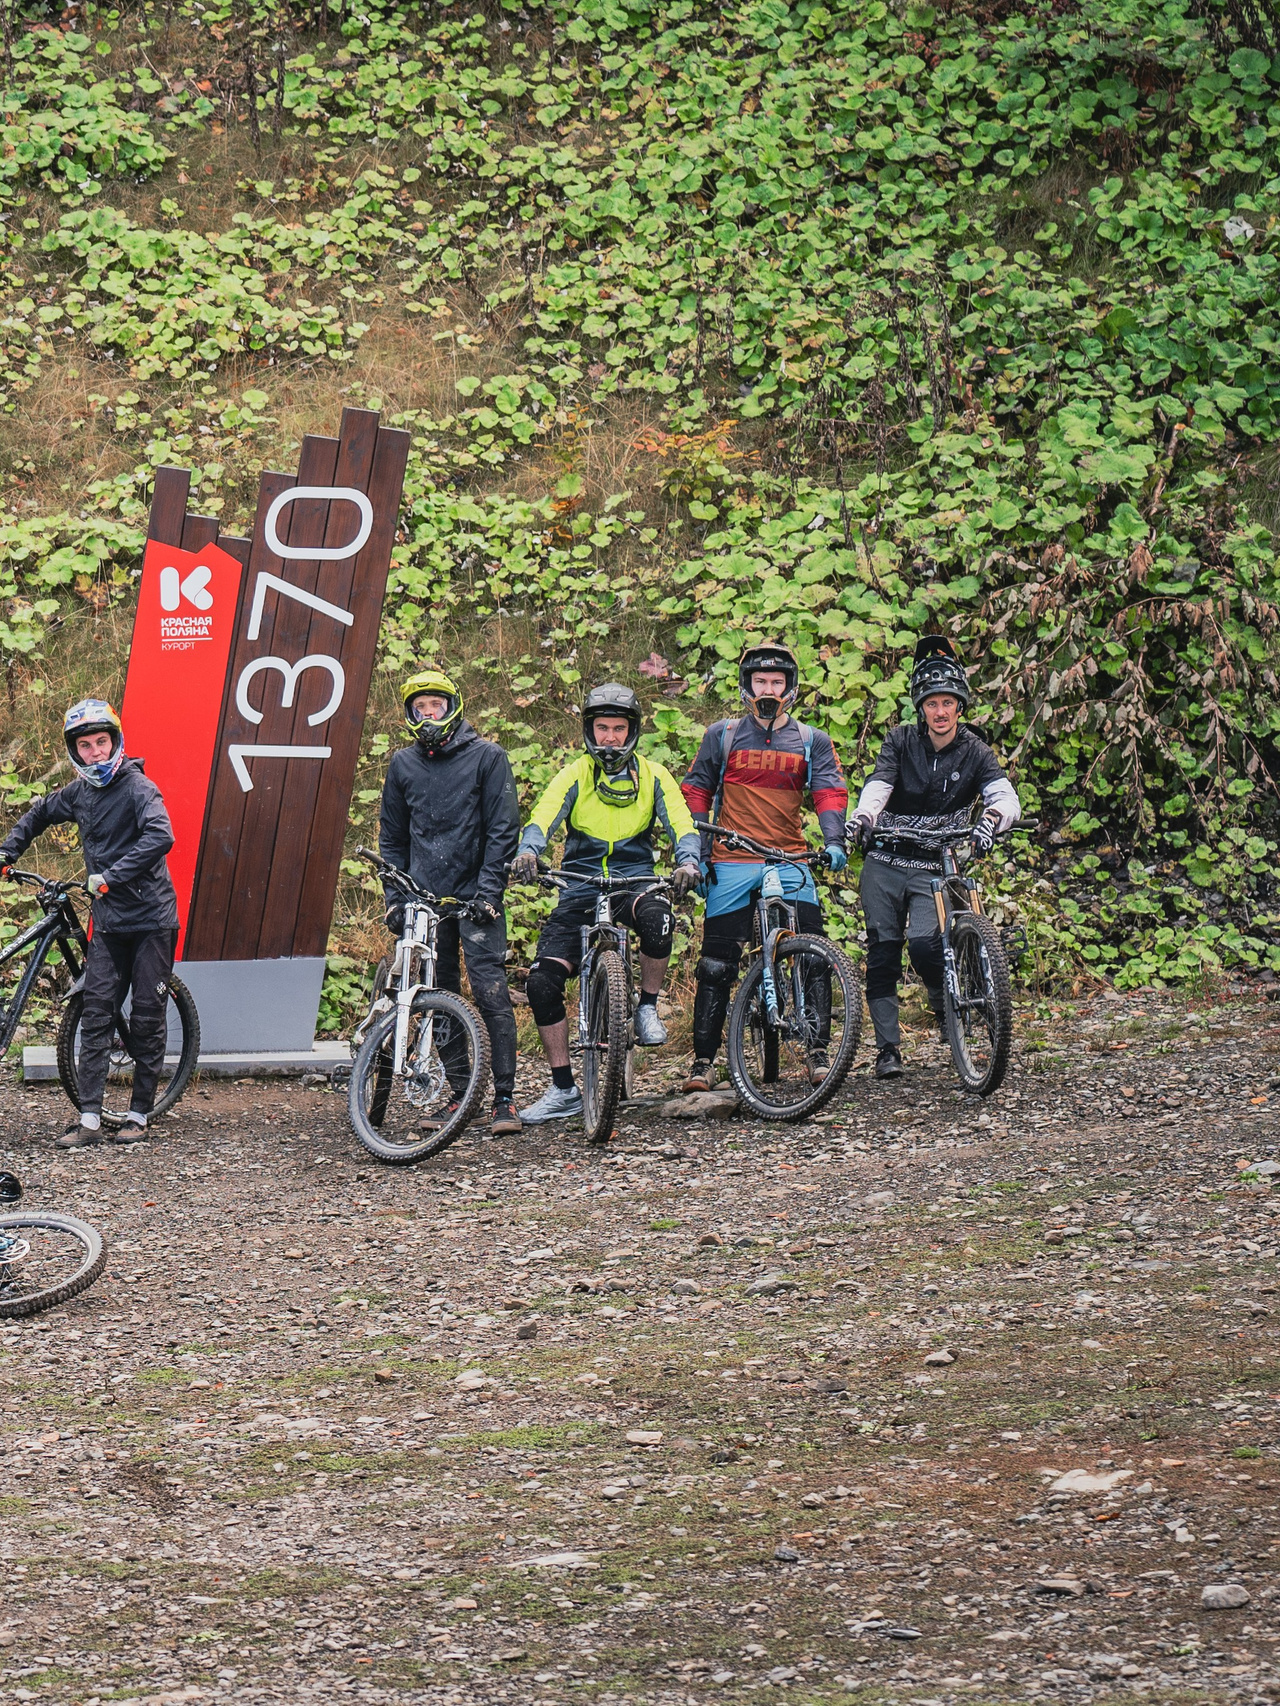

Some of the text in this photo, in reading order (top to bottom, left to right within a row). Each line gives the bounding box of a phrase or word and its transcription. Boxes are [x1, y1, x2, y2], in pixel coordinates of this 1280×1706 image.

[161, 616, 213, 627] КРАСНАЯ
[161, 626, 209, 637] ПОЛЯНА
[161, 642, 196, 651] КУРОРТ
[228, 486, 374, 793] 1370
[735, 749, 804, 773] LEATT
[763, 978, 779, 1012] LYRIK
[733, 1072, 756, 1103] MAXXIS
